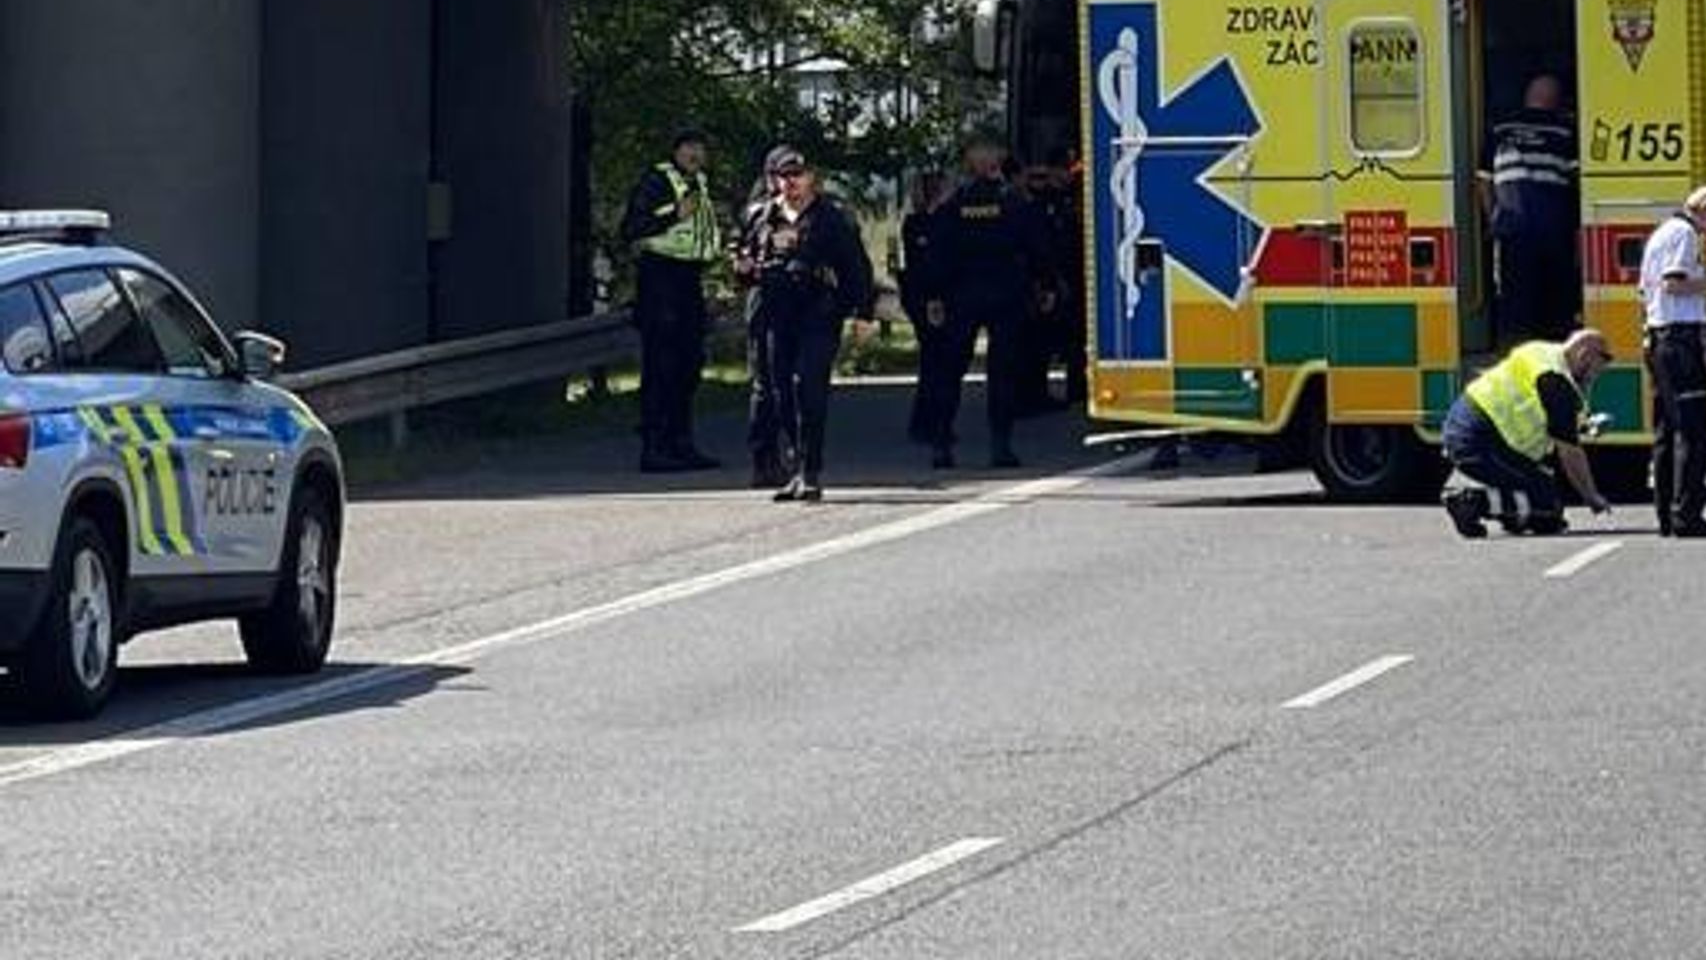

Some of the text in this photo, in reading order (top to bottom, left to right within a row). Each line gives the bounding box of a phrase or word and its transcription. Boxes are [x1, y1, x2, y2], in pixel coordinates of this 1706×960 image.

[1226, 7, 1317, 33] ZDRAV
[1616, 122, 1684, 162] 155
[207, 468, 275, 515] POLICIE
